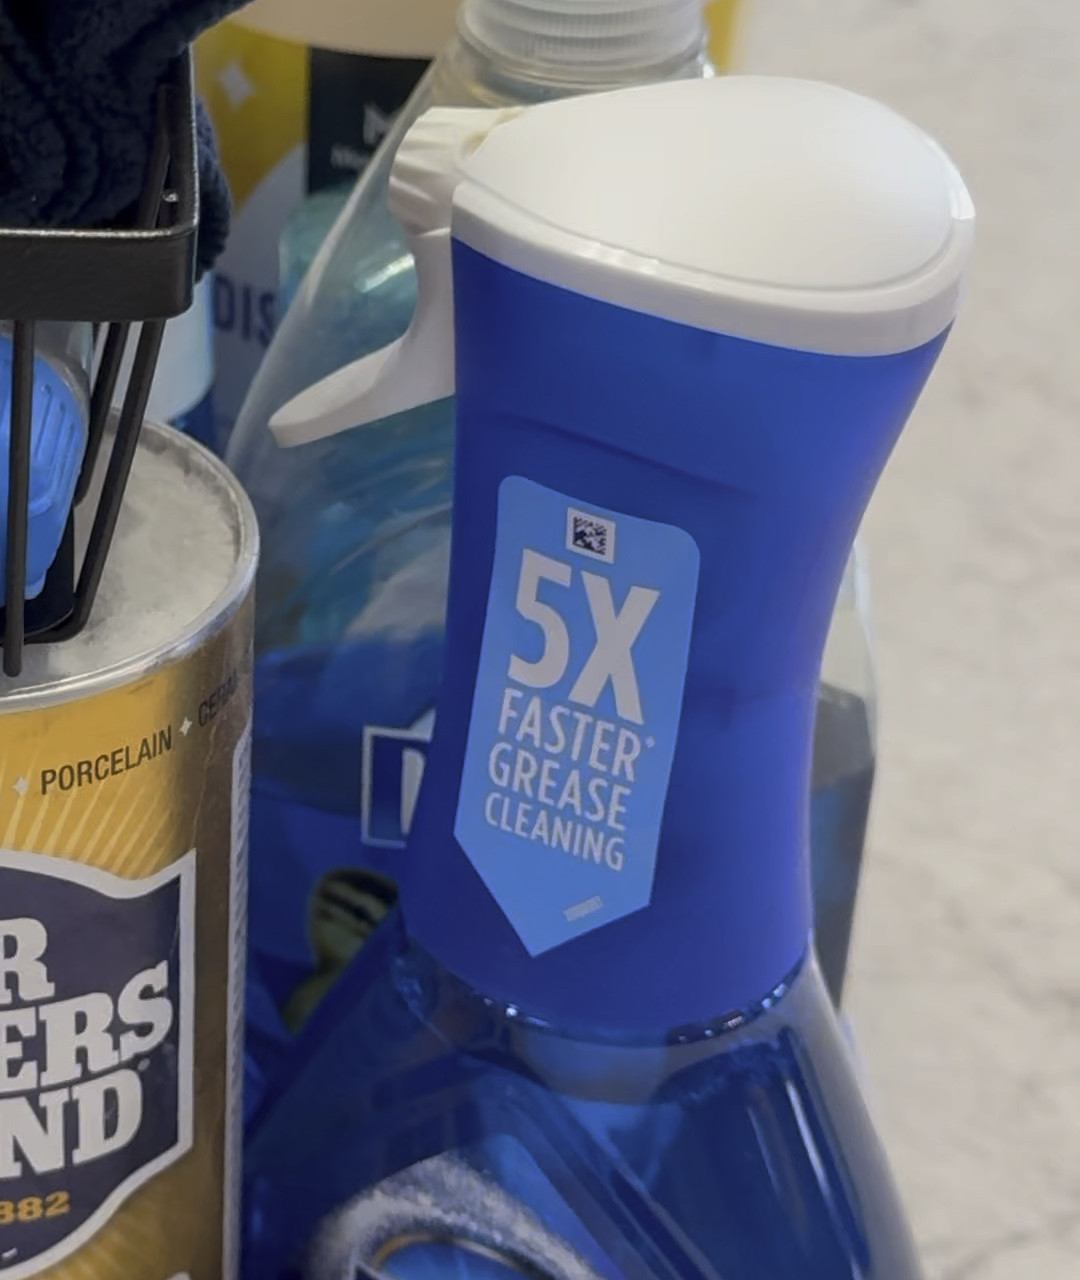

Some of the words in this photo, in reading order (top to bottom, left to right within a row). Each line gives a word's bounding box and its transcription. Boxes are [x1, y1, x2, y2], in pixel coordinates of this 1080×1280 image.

[214, 274, 276, 348] DIS
[507, 547, 660, 725] 5X
[39, 724, 174, 796] PORCELAIN
[488, 742, 632, 831] GREASE
[484, 791, 624, 872] CLEANING
